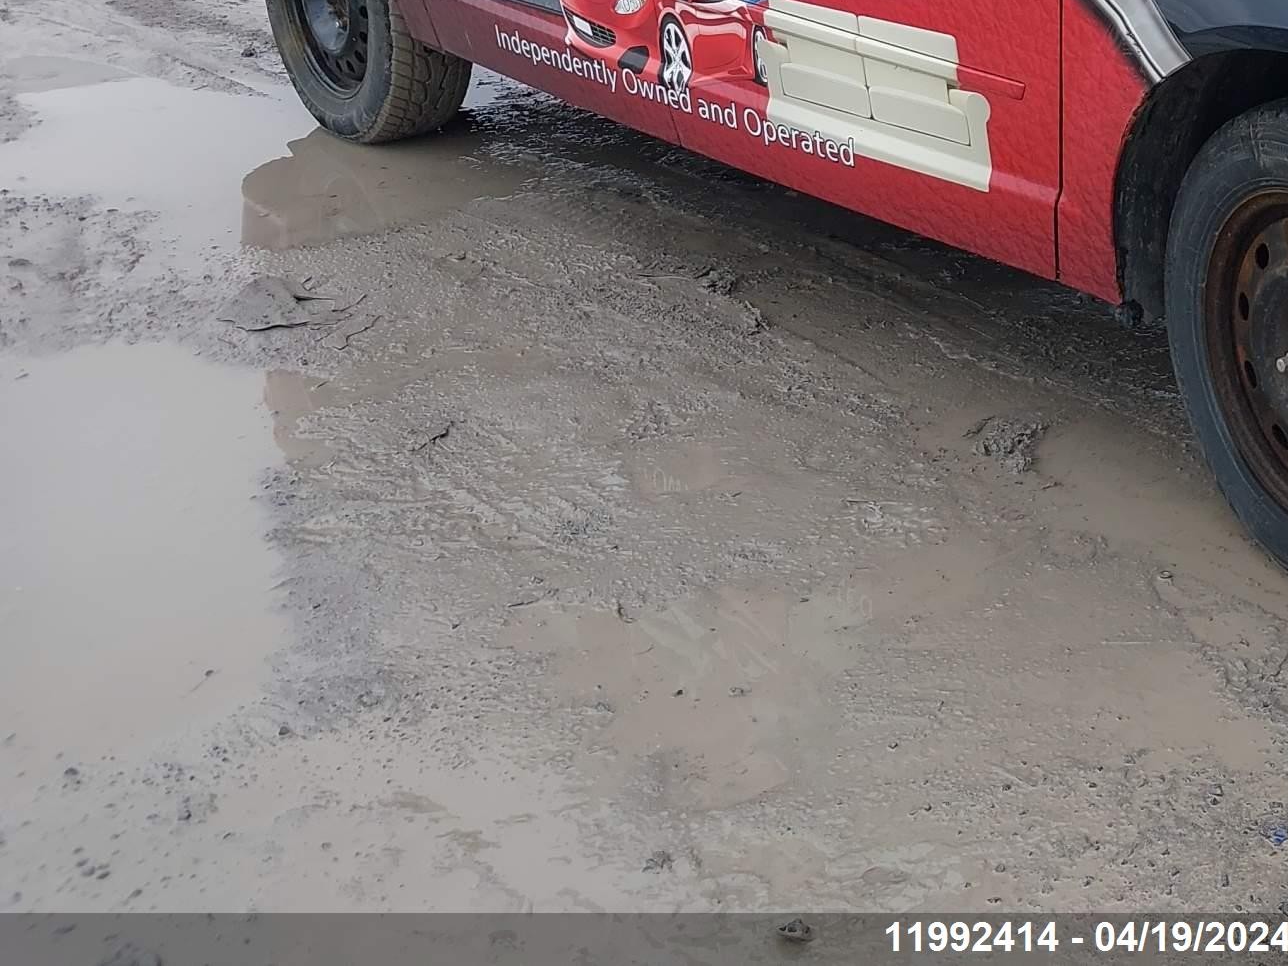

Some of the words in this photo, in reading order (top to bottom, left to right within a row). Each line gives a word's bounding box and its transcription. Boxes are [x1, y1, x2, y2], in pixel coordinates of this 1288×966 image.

[494, 24, 617, 92] Independently
[621, 68, 693, 114] Owned
[698, 97, 737, 130] and
[743, 108, 855, 167] Operated
